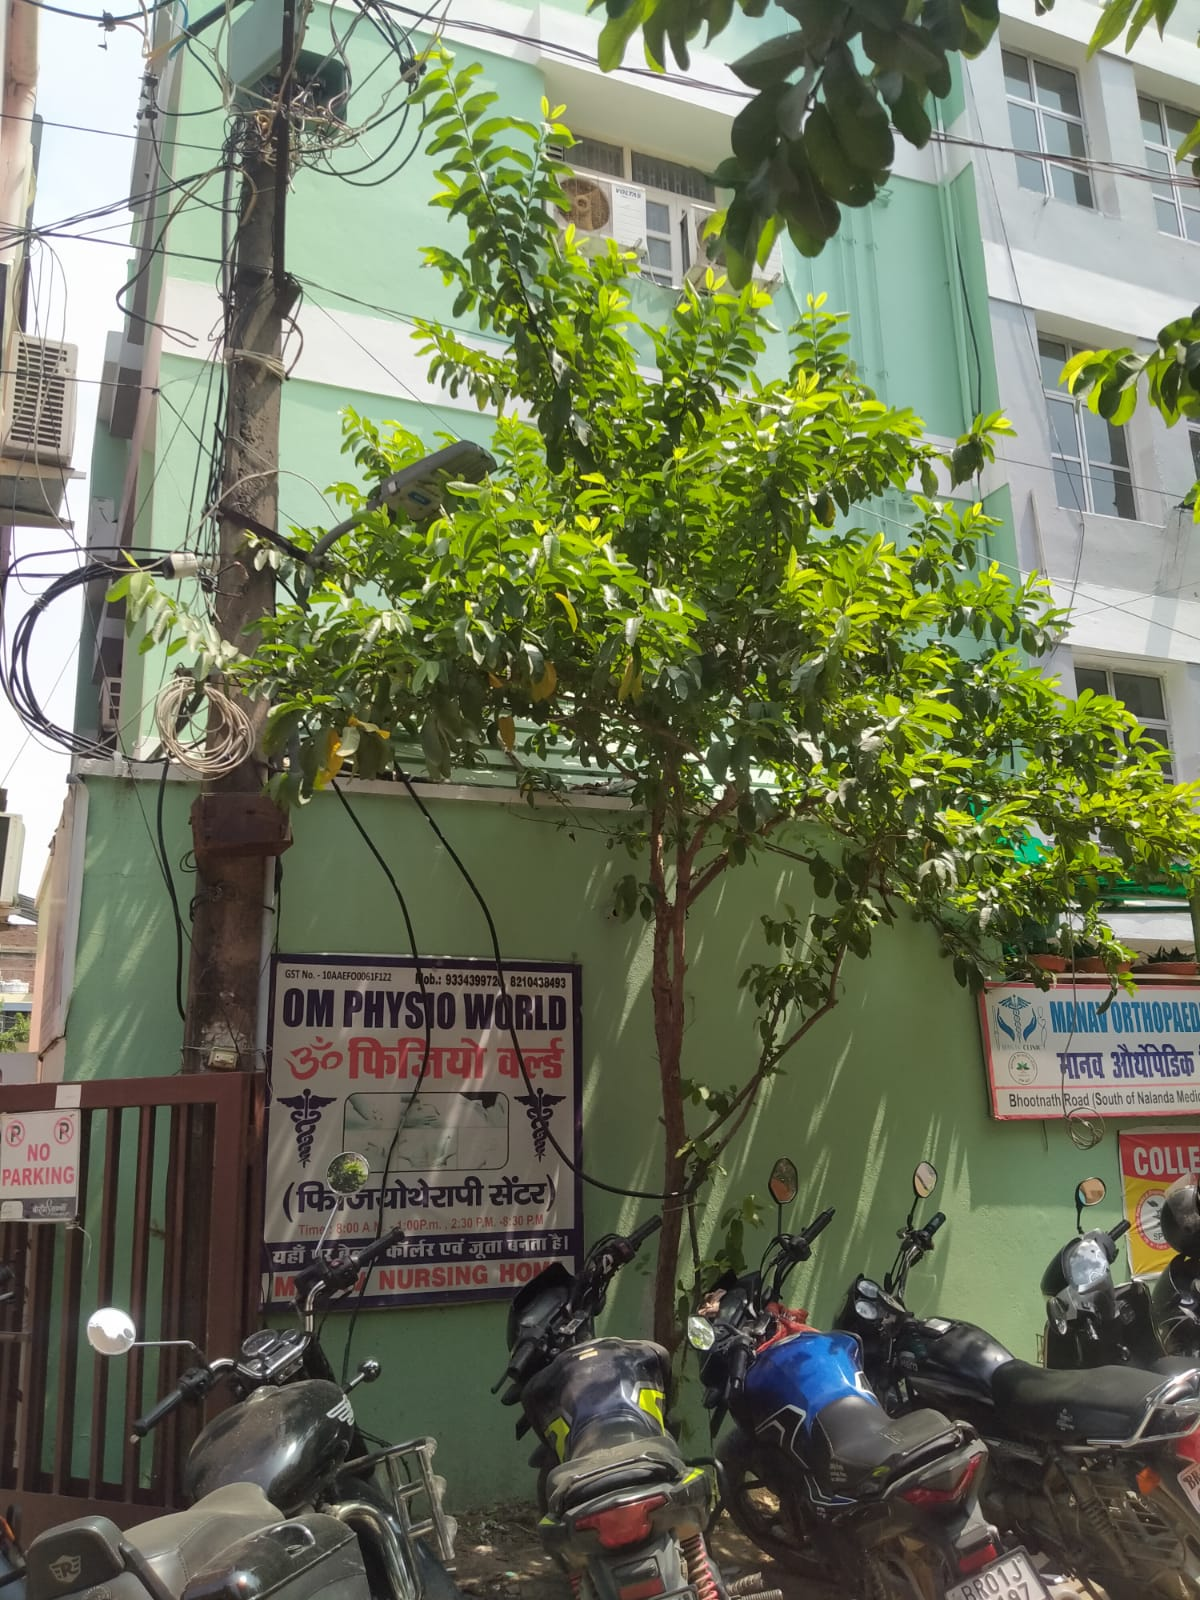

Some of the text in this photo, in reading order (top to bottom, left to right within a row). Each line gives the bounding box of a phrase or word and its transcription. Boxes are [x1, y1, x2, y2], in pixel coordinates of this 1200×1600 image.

[285, 969, 300, 980] GST
[301, 969, 315, 980] No.
[510, 976, 566, 988] 8210438493
[282, 988, 567, 1031] OM PHYSIO WORLD
[1049, 1001, 1200, 1034] MANAV ORTHOPAED
[348, 1036, 488, 1080] फिजियो
[496, 1036, 565, 1080] वर्ल्ड
[1056, 1051, 1106, 1080] मानव
[1008, 1092, 1063, 1108] Bhootnath
[1064, 1092, 1090, 1107] Road
[1092, 1091, 1125, 1109] (South
[1126, 1091, 1135, 1106] of
[1136, 1090, 1175, 1105] Nalanda
[27, 1142, 51, 1162] NO
[1, 1166, 75, 1187] PARKING
[336, 1222, 359, 1234] 8:00
[450, 1218, 473, 1230] 2:30
[272, 1244, 306, 1265] यहाँ
[440, 1238, 465, 1256] एवं
[468, 1240, 503, 1259] जूता
[506, 1237, 548, 1253] बनता
[379, 1264, 488, 1292] NURSING
[499, 1261, 555, 1284] HOM
